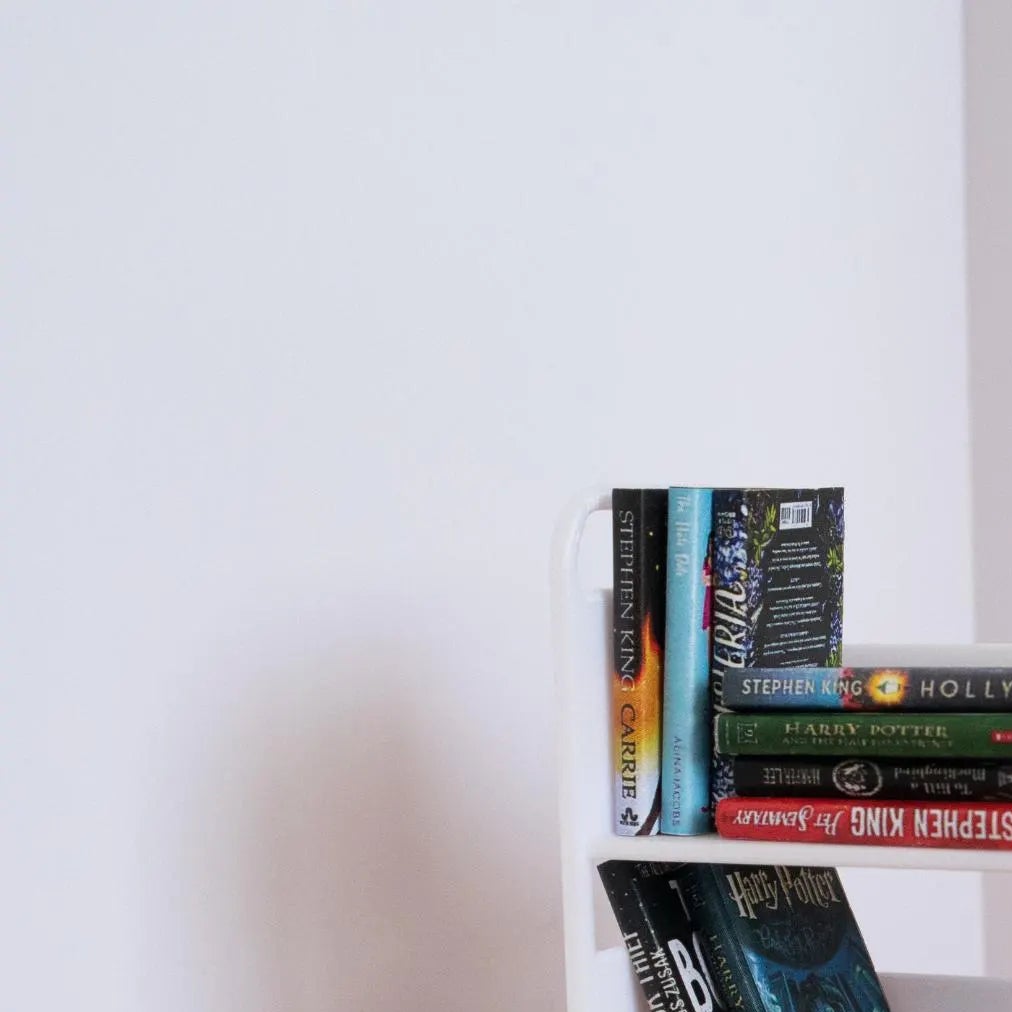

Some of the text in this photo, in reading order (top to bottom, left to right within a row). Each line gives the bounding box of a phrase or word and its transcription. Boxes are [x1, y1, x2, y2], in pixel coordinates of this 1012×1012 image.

[618, 509, 635, 693] STEPHEN KING
[741, 678, 863, 696] STEPHEN KING
[784, 722, 949, 738] HARRY POTTER
[620, 702, 637, 800] CARRIE
[763, 767, 782, 785] LEE
[850, 805, 905, 837] KING
[726, 869, 779, 920] Harry
[650, 946, 683, 999] ZUSAK
